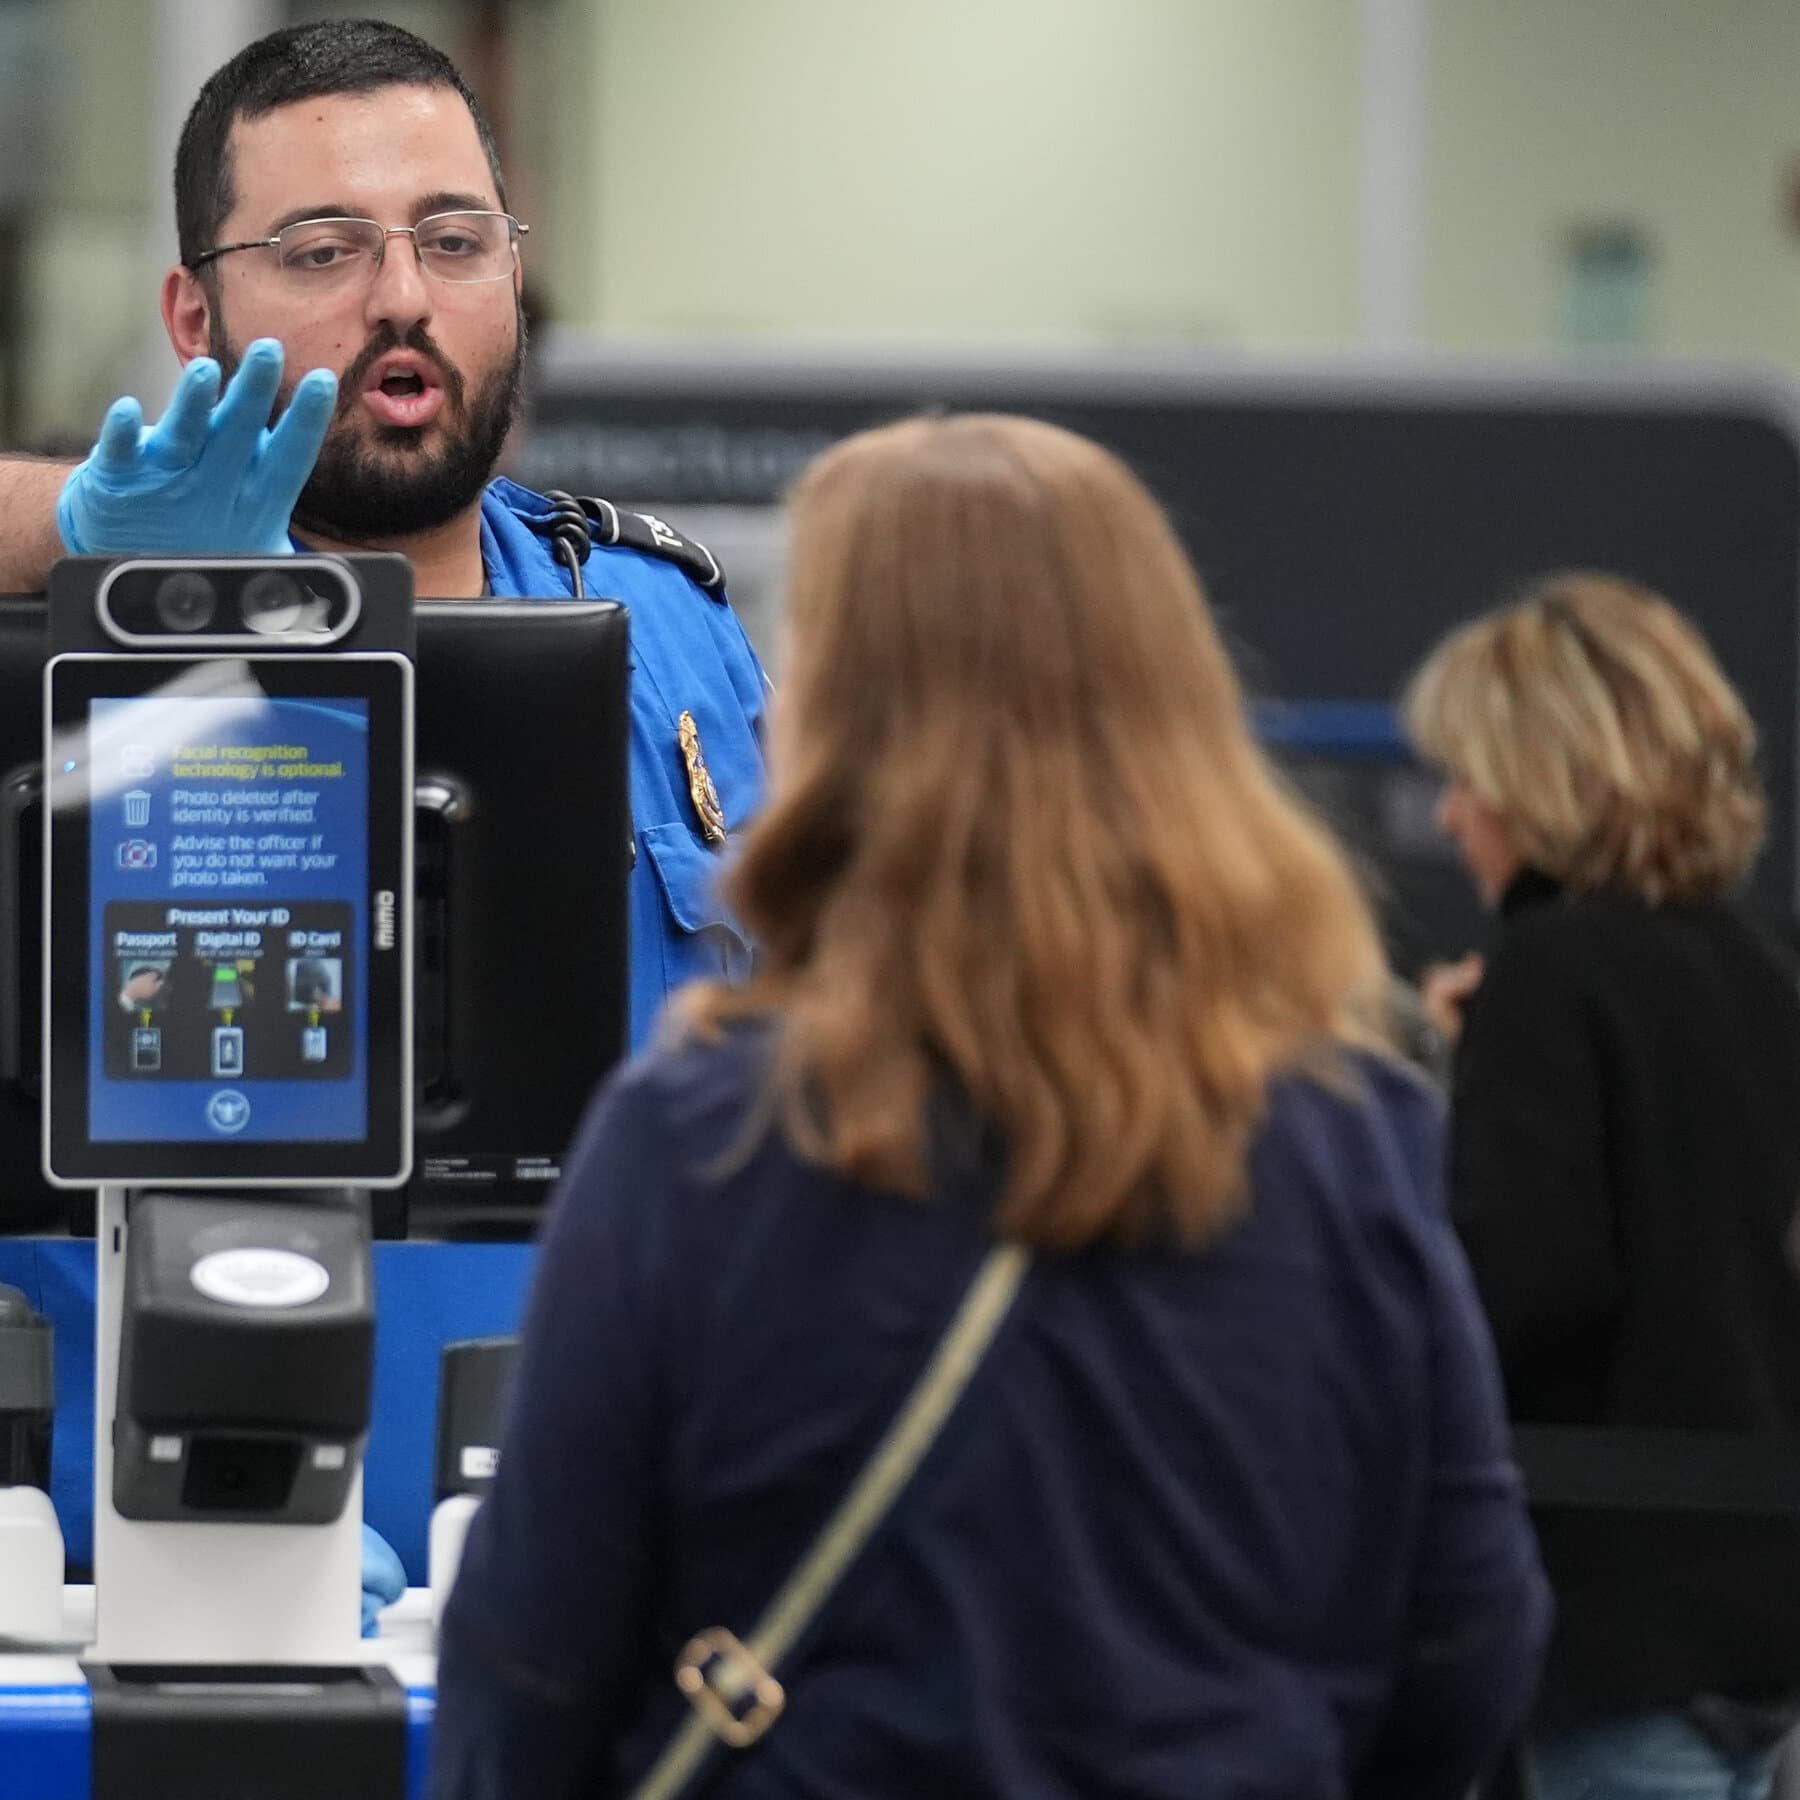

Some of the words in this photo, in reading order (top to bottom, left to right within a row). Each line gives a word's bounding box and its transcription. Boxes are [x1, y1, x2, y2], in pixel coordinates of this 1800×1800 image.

[220, 745, 308, 762] recognition
[174, 762, 258, 780] technology
[262, 763, 275, 777] is
[278, 762, 346, 780] optional.
[173, 790, 218, 805] Photo
[222, 790, 279, 805] deleted
[281, 790, 319, 805] after
[173, 808, 232, 825] identity
[237, 808, 249, 823] is
[253, 808, 316, 823] verified.
[173, 835, 225, 850] Advise
[229, 835, 254, 850] the
[258, 834, 306, 850] officer
[310, 834, 322, 850] if
[173, 854, 202, 869] you
[207, 853, 226, 867] do
[230, 853, 255, 867] not
[259, 854, 297, 867] want
[302, 854, 336, 869] your
[172, 870, 217, 887] photo
[221, 870, 268, 886] taken.
[168, 909, 229, 925] Present
[232, 909, 269, 925] Your
[271, 909, 290, 925] ID
[375, 890, 395, 951] mimo
[117, 932, 177, 948] Passport
[198, 932, 242, 948] Digital
[244, 932, 261, 946] ID
[289, 932, 306, 946] ID
[308, 932, 341, 946] Card
